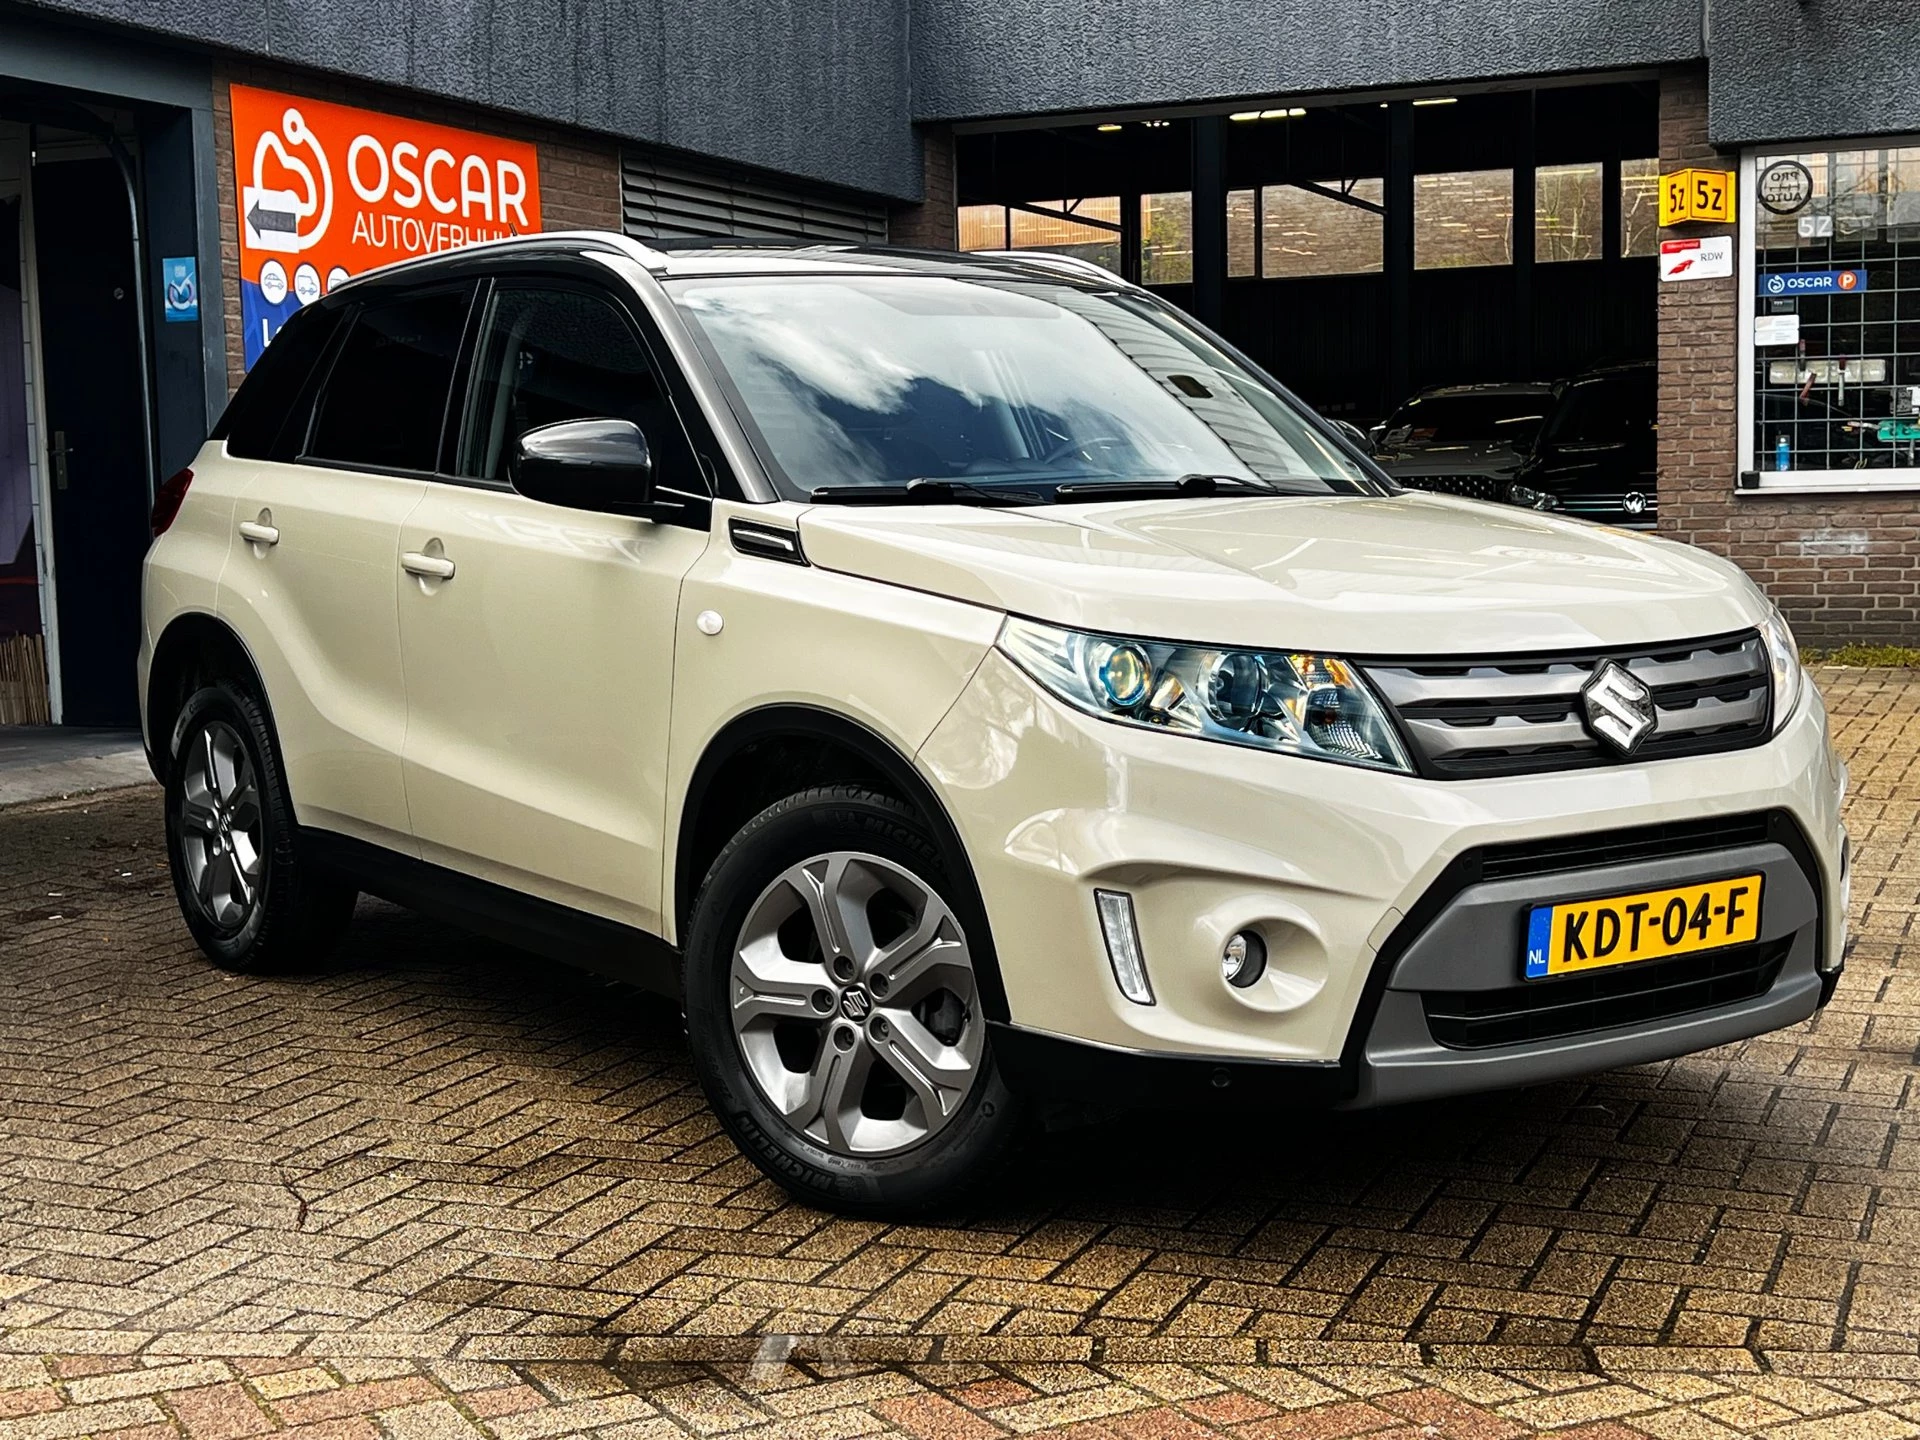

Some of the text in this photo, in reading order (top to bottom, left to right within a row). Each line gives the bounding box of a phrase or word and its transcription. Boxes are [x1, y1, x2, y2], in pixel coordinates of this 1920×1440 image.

[347, 134, 529, 226] OSCAR
[1700, 252, 1724, 262] RDW
[1787, 274, 1854, 289] OSCAR P
[863, 815, 945, 873] MICHEL
[1563, 886, 1749, 963] KDT-04-F
[1529, 949, 1546, 966] NL
[734, 1112, 834, 1192] MICHELIN
